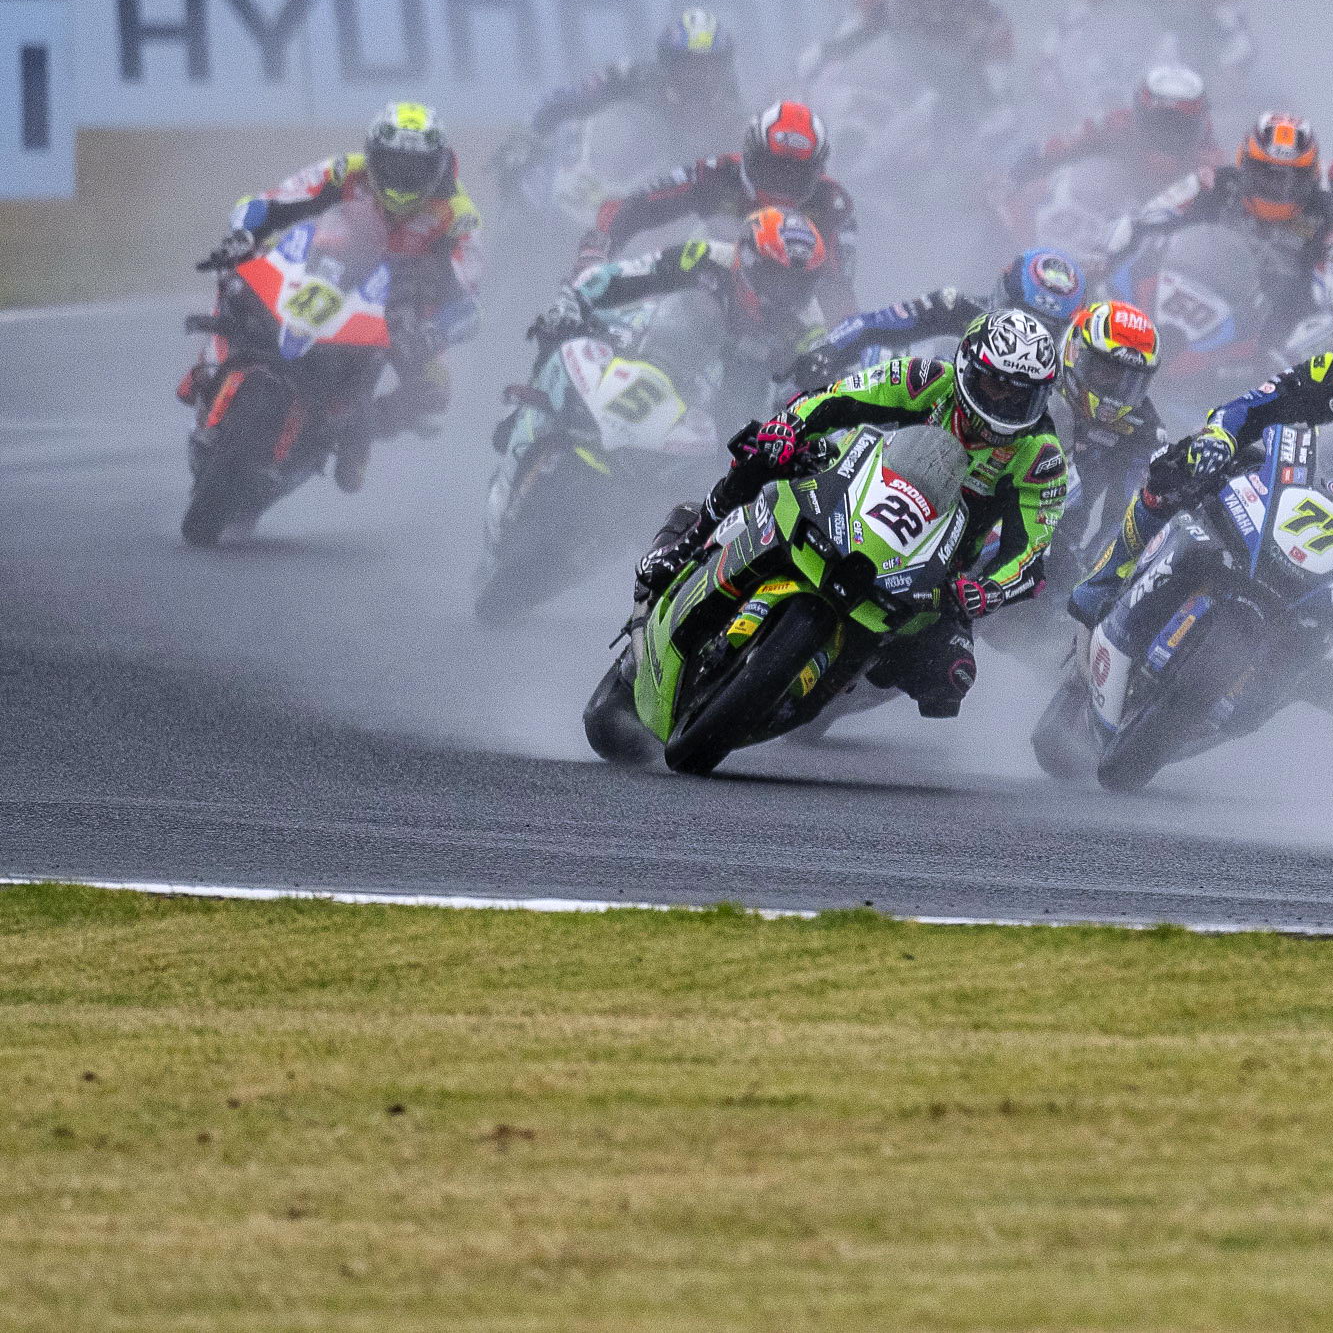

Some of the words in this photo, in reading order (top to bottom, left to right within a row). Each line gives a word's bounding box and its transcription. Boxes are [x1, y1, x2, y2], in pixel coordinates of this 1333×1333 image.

[1003, 360, 1041, 375] SHARK
[838, 432, 876, 479] Kawasaki
[755, 493, 770, 529] elf
[888, 479, 931, 517] SHOWA
[1224, 495, 1255, 537] YAMAHA
[853, 520, 863, 536] elf
[866, 495, 924, 548] 22
[938, 509, 967, 565] Kawasaki
[882, 559, 896, 570] elf
